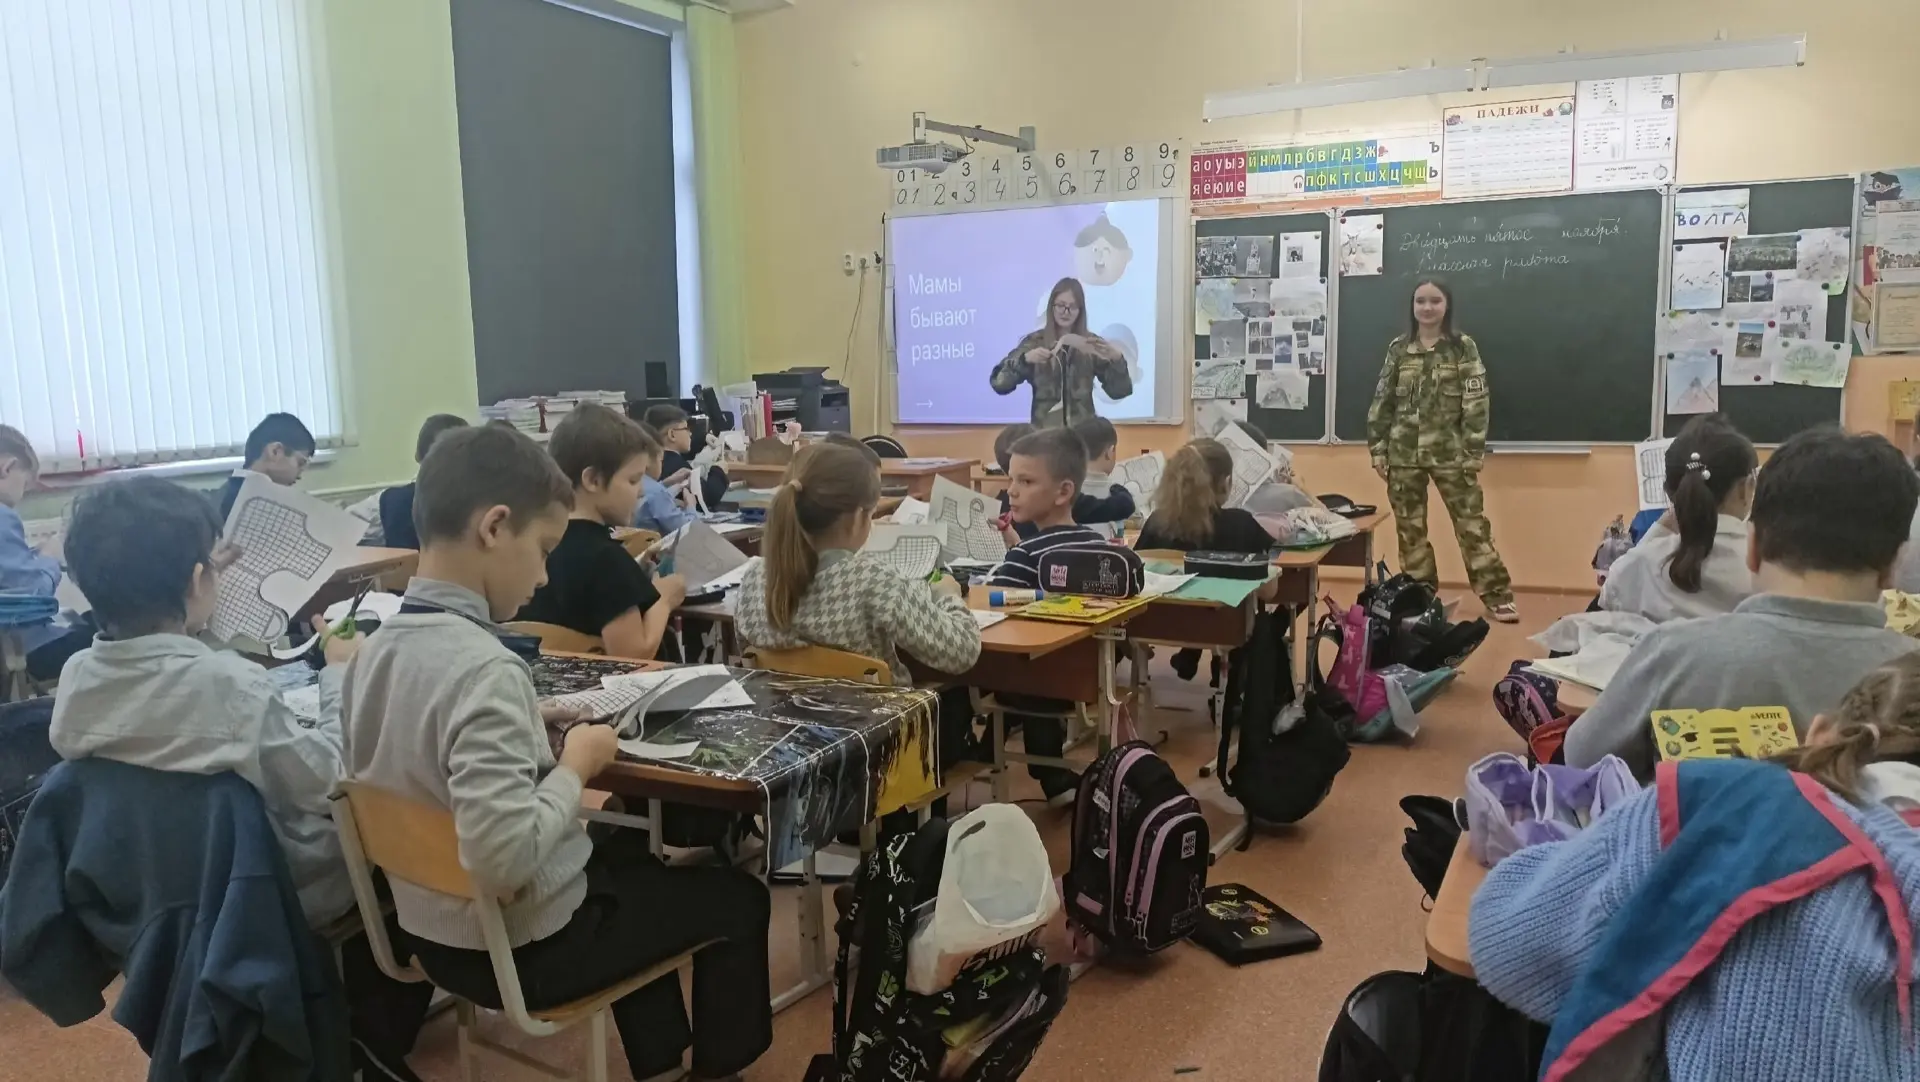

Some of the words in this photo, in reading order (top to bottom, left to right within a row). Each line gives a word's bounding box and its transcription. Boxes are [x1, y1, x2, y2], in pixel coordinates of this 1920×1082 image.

[1477, 105, 1539, 119] ПАДЕЖИ
[961, 162, 971, 177] 3
[991, 159, 1001, 174] 4
[1022, 156, 1032, 171] 5
[1055, 153, 1065, 168] 6
[1090, 150, 1100, 165] 7
[1124, 146, 1134, 162] 8
[1159, 143, 1169, 159] 9
[933, 183, 946, 206] 2
[963, 181, 977, 204] 3
[994, 178, 1006, 201] 4
[1025, 176, 1038, 199] 5
[1058, 172, 1072, 196] 6
[1093, 169, 1106, 193] 7
[1126, 166, 1140, 191] 8
[1161, 164, 1175, 188] 9
[1677, 211, 1747, 227] ВОЛГА
[909, 273, 962, 296] Мамы
[910, 306, 978, 329] бывают
[911, 341, 975, 367] разные
